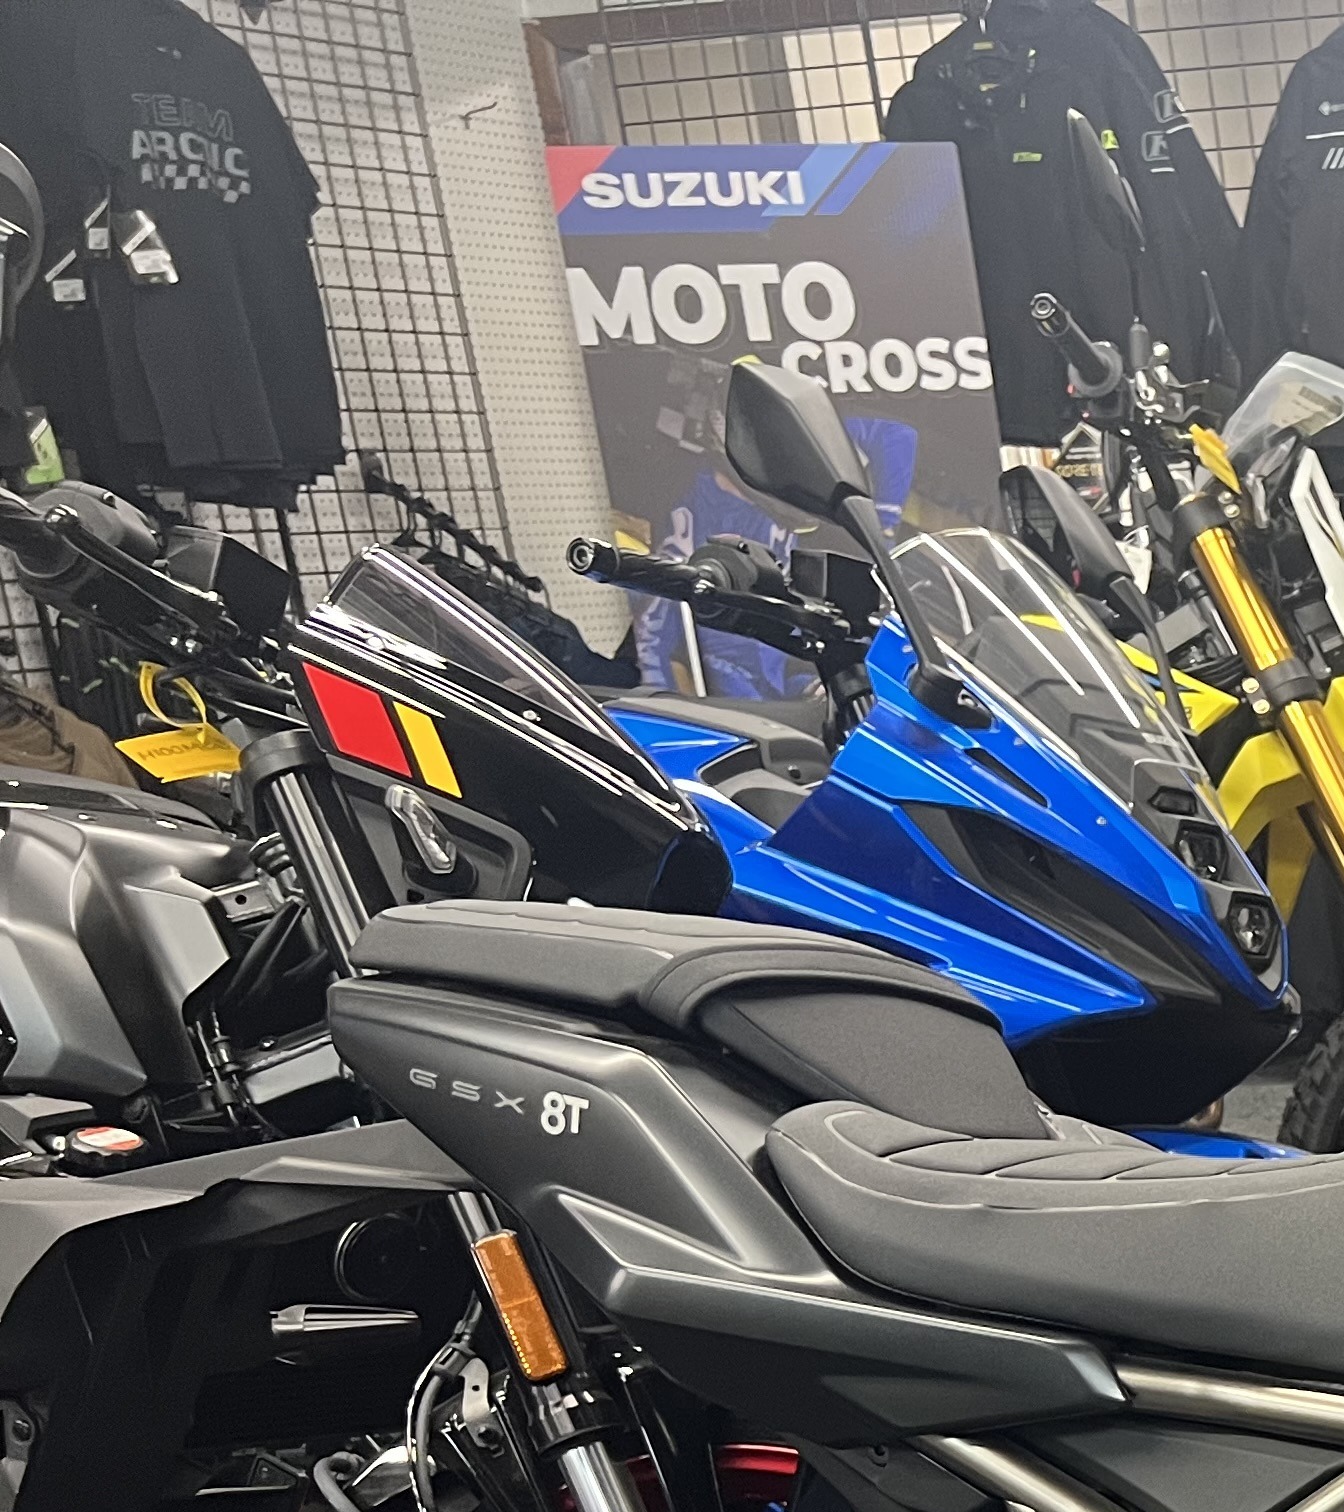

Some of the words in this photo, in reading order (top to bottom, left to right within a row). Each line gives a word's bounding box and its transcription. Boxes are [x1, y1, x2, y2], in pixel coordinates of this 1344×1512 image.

[581, 170, 806, 208] SUZUKI
[565, 261, 856, 347] MOTO
[781, 337, 994, 393] CROSS
[540, 1091, 590, 1135] 8T
